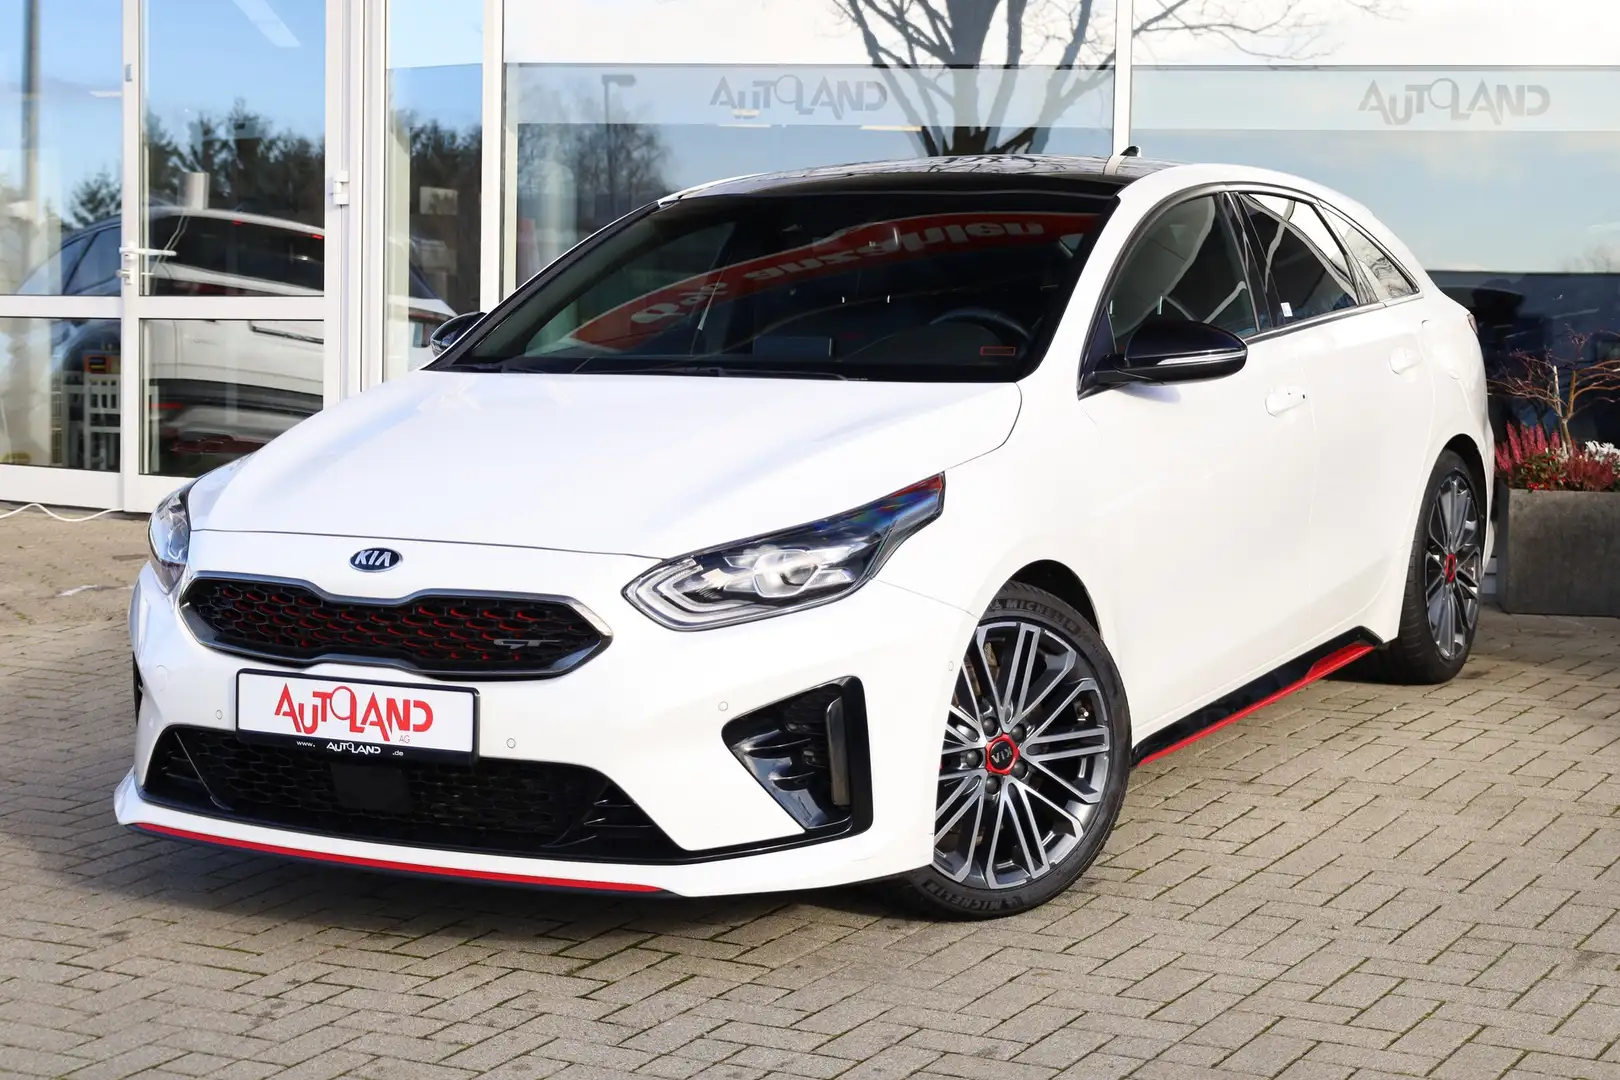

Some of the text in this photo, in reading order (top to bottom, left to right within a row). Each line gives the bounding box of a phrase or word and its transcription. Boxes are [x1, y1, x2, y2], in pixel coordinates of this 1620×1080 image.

[709, 74, 888, 120] AUTOLAND
[1357, 77, 1551, 126] AUTOLAND
[355, 550, 391, 567] KIA
[493, 638, 559, 649] GT
[274, 683, 434, 742] AUTOLAND
[296, 740, 316, 748] www.
[326, 741, 381, 755] AUTOLAND
[399, 734, 410, 744] AG
[991, 746, 1012, 763] KIA
